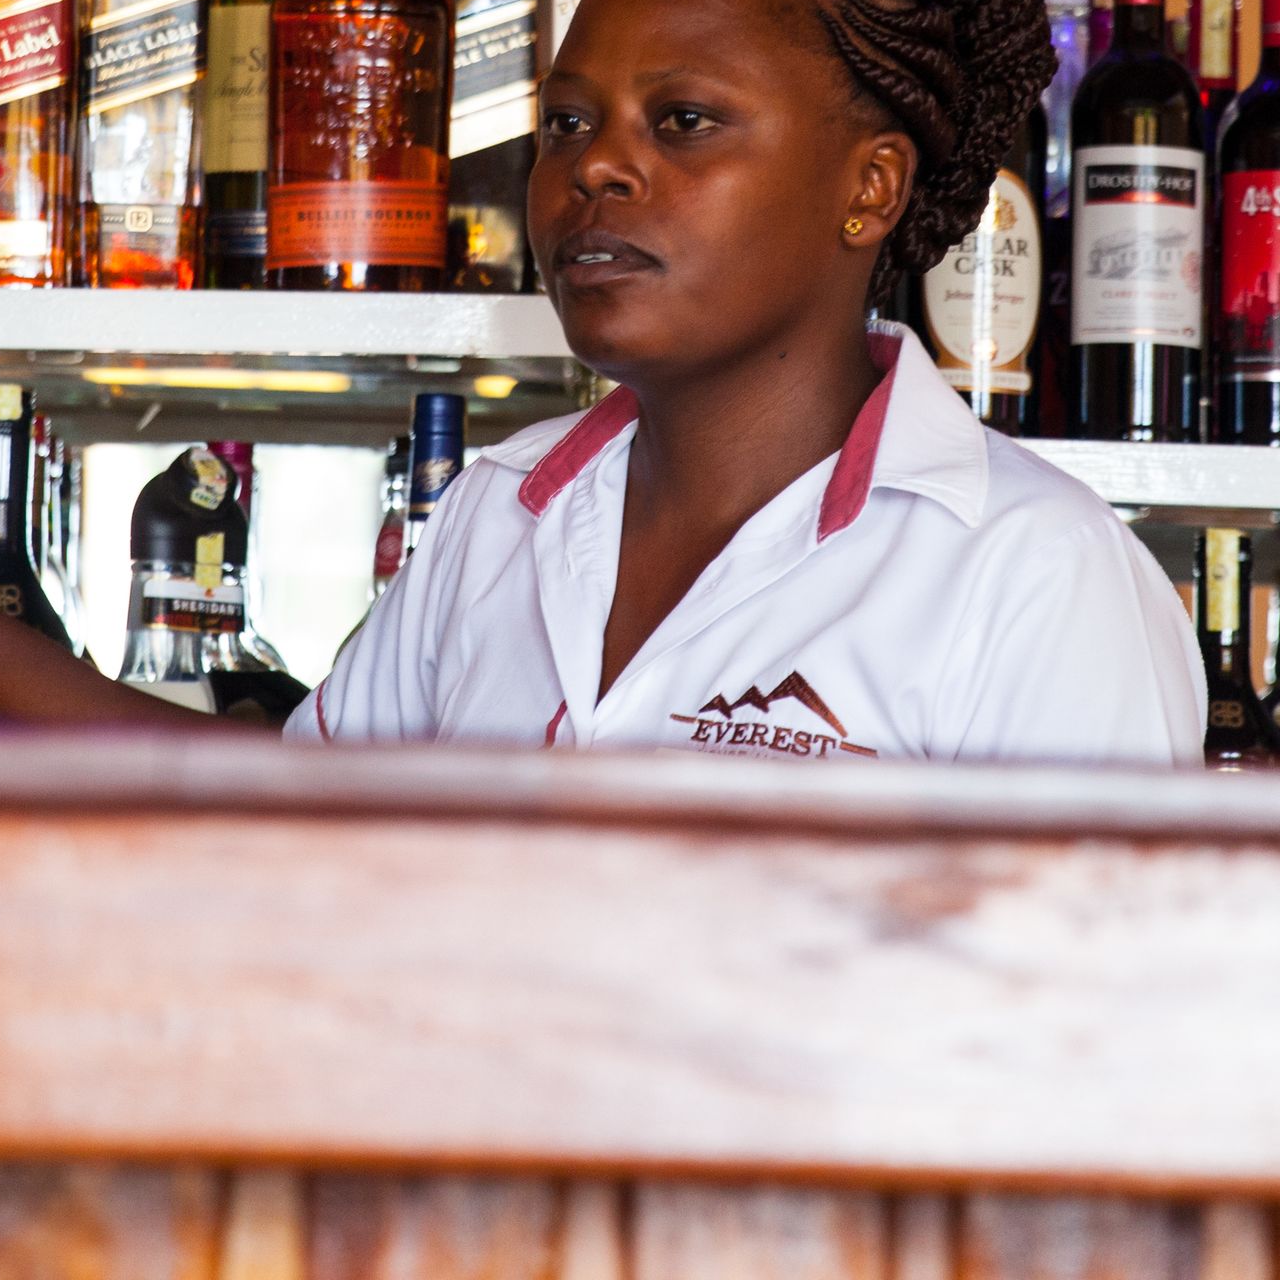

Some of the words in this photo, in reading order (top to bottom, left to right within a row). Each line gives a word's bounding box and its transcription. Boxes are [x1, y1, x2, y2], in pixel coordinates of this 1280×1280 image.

[0, 23, 62, 62] Label
[143, 21, 200, 52] LABEL
[689, 717, 839, 761] EVEREST
